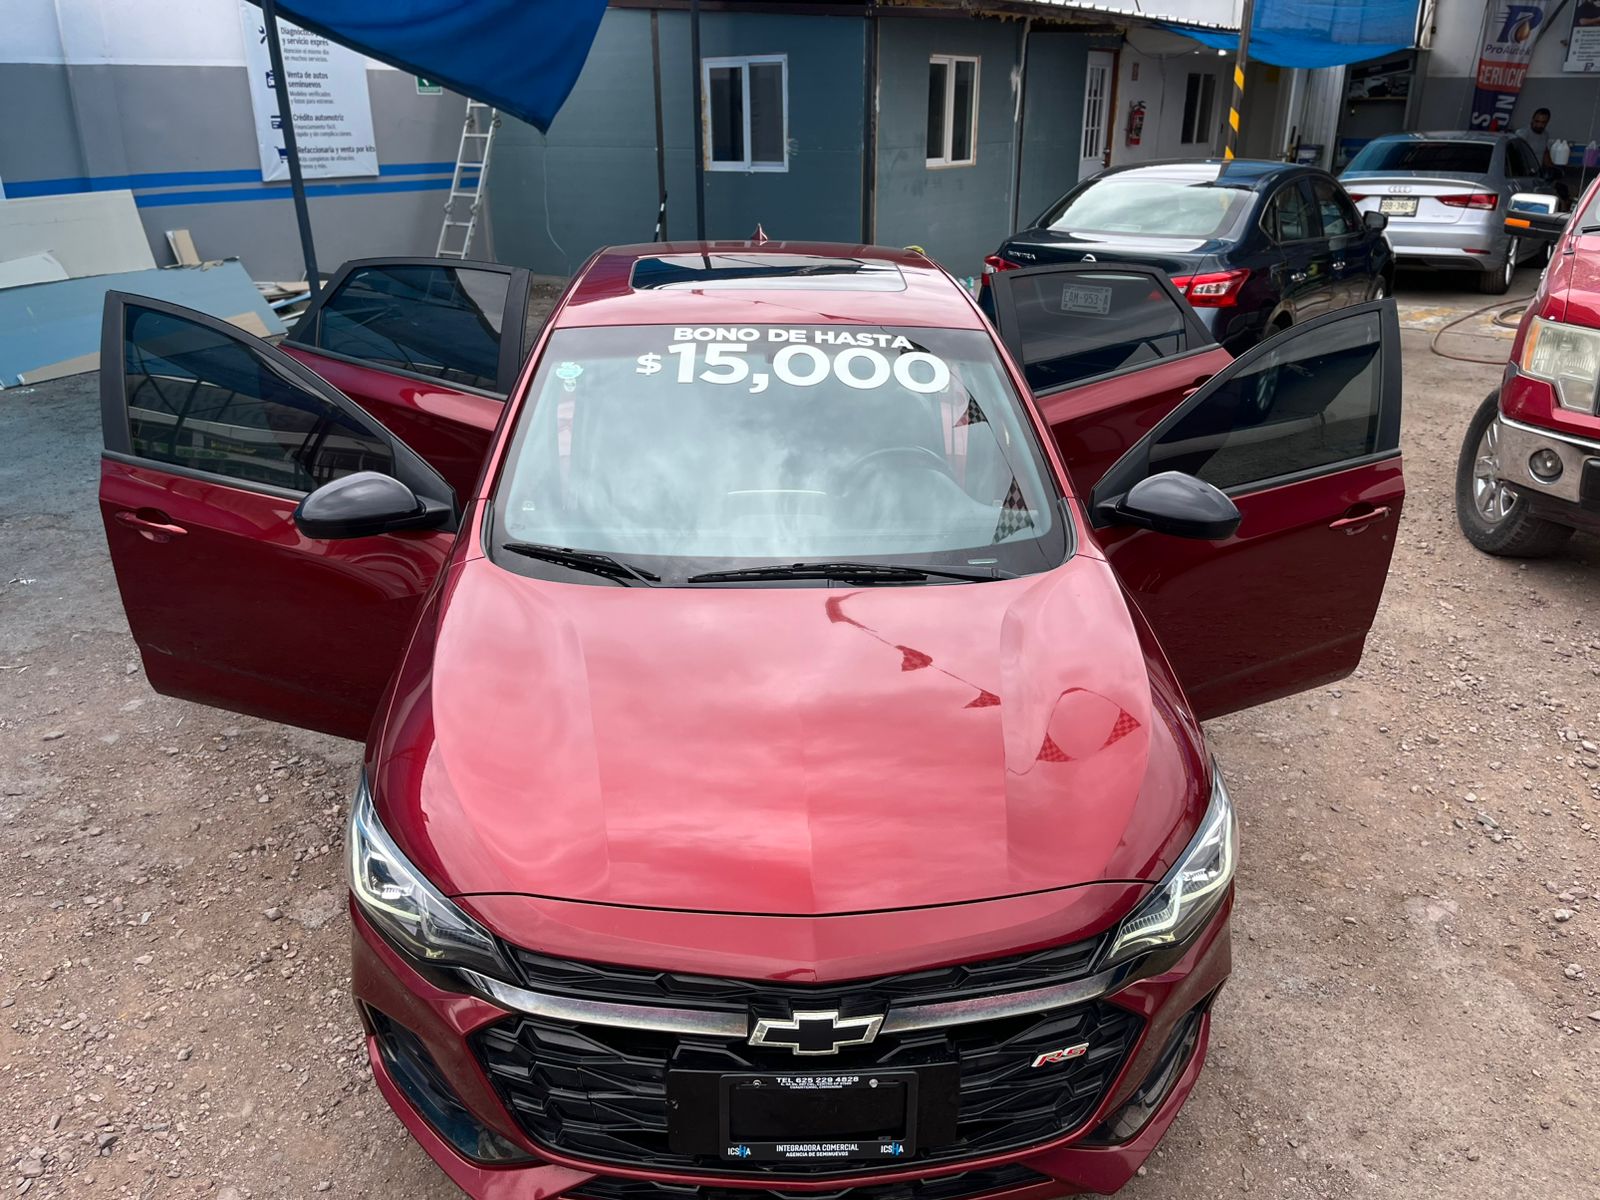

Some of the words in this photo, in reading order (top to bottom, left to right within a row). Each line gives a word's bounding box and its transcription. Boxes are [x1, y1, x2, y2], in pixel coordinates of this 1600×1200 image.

[304, 71, 311, 79] de
[673, 327, 760, 341] BONO
[768, 329, 806, 343] DE
[815, 331, 914, 349] HASTA
[636, 342, 951, 394] $15,000
[1031, 1042, 1090, 1068] RS
[776, 1144, 821, 1152] INTEGRADORA
[822, 1143, 859, 1151] COMERCIAL
